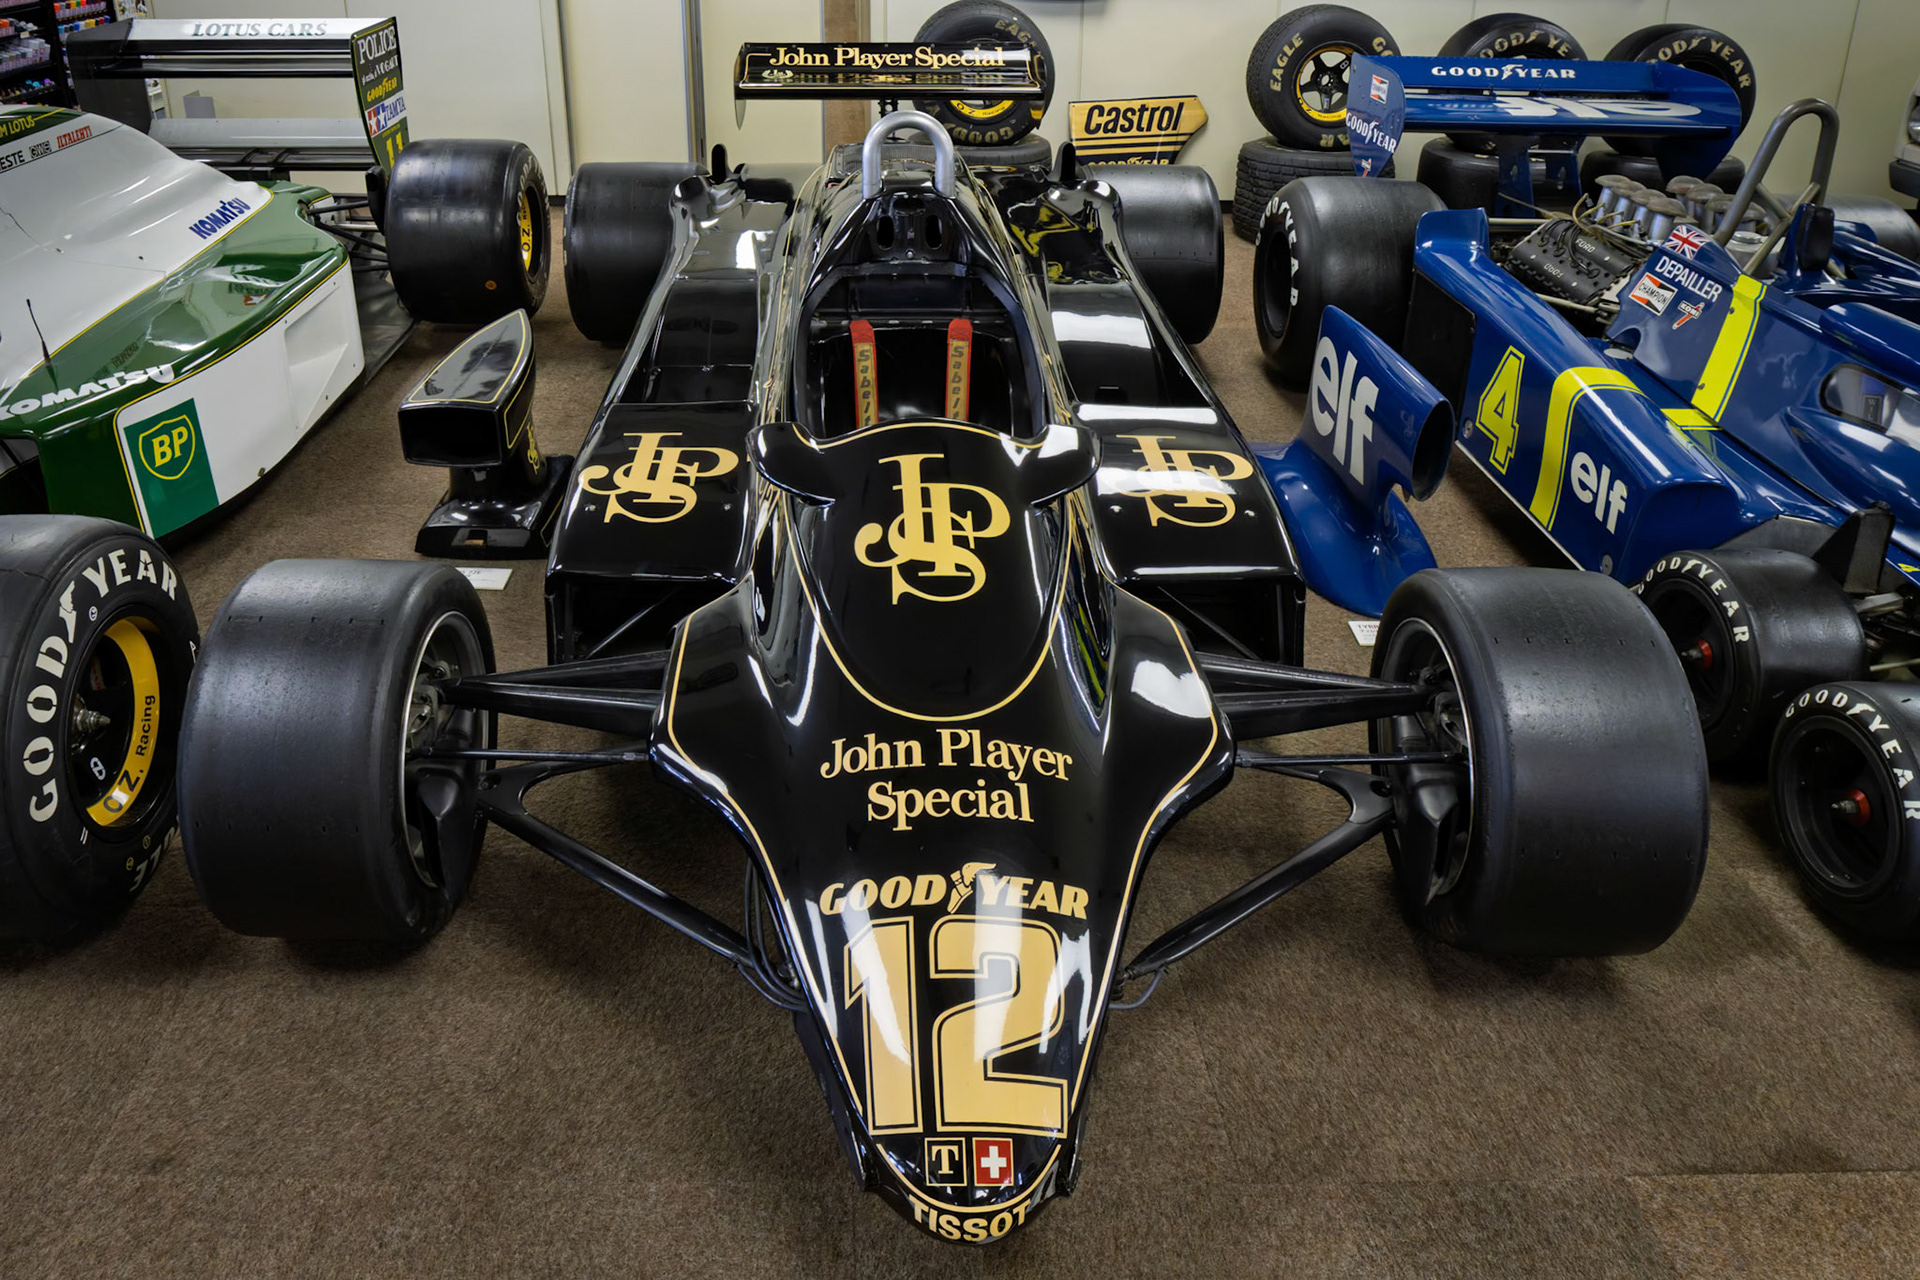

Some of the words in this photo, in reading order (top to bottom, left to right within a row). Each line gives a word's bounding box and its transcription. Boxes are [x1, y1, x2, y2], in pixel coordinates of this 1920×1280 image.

[192, 23, 261, 37] LOTUS
[268, 22, 327, 37] CARS
[357, 26, 397, 64] POLICE
[769, 47, 831, 66] John
[834, 47, 913, 68] Player
[915, 46, 1006, 69] Special
[1270, 33, 1304, 91] EAGLE
[8, 115, 35, 134] LOTUS
[56, 125, 93, 149] ILTALEHTI
[1084, 102, 1185, 135] Castrol
[188, 197, 251, 240] KOMATSU
[1574, 238, 1596, 254] FORD
[1543, 263, 1564, 278] FORD
[1654, 255, 1723, 303] DEPAILLER
[1638, 282, 1670, 306] CHAMPION
[857, 349, 871, 426] Sabelt
[951, 345, 965, 420] Sabelt
[1312, 336, 1379, 485] elf
[1475, 345, 1525, 475] 4
[151, 426, 188, 468] BP
[1570, 452, 1628, 535] elf
[136, 695, 155, 757] Racing
[820, 733, 926, 779] John
[936, 728, 1073, 781] Player
[867, 779, 1035, 831] Special
[844, 914, 1068, 1139] 12
[932, 1145, 959, 1174] T
[909, 1194, 1031, 1242] TISSOT
